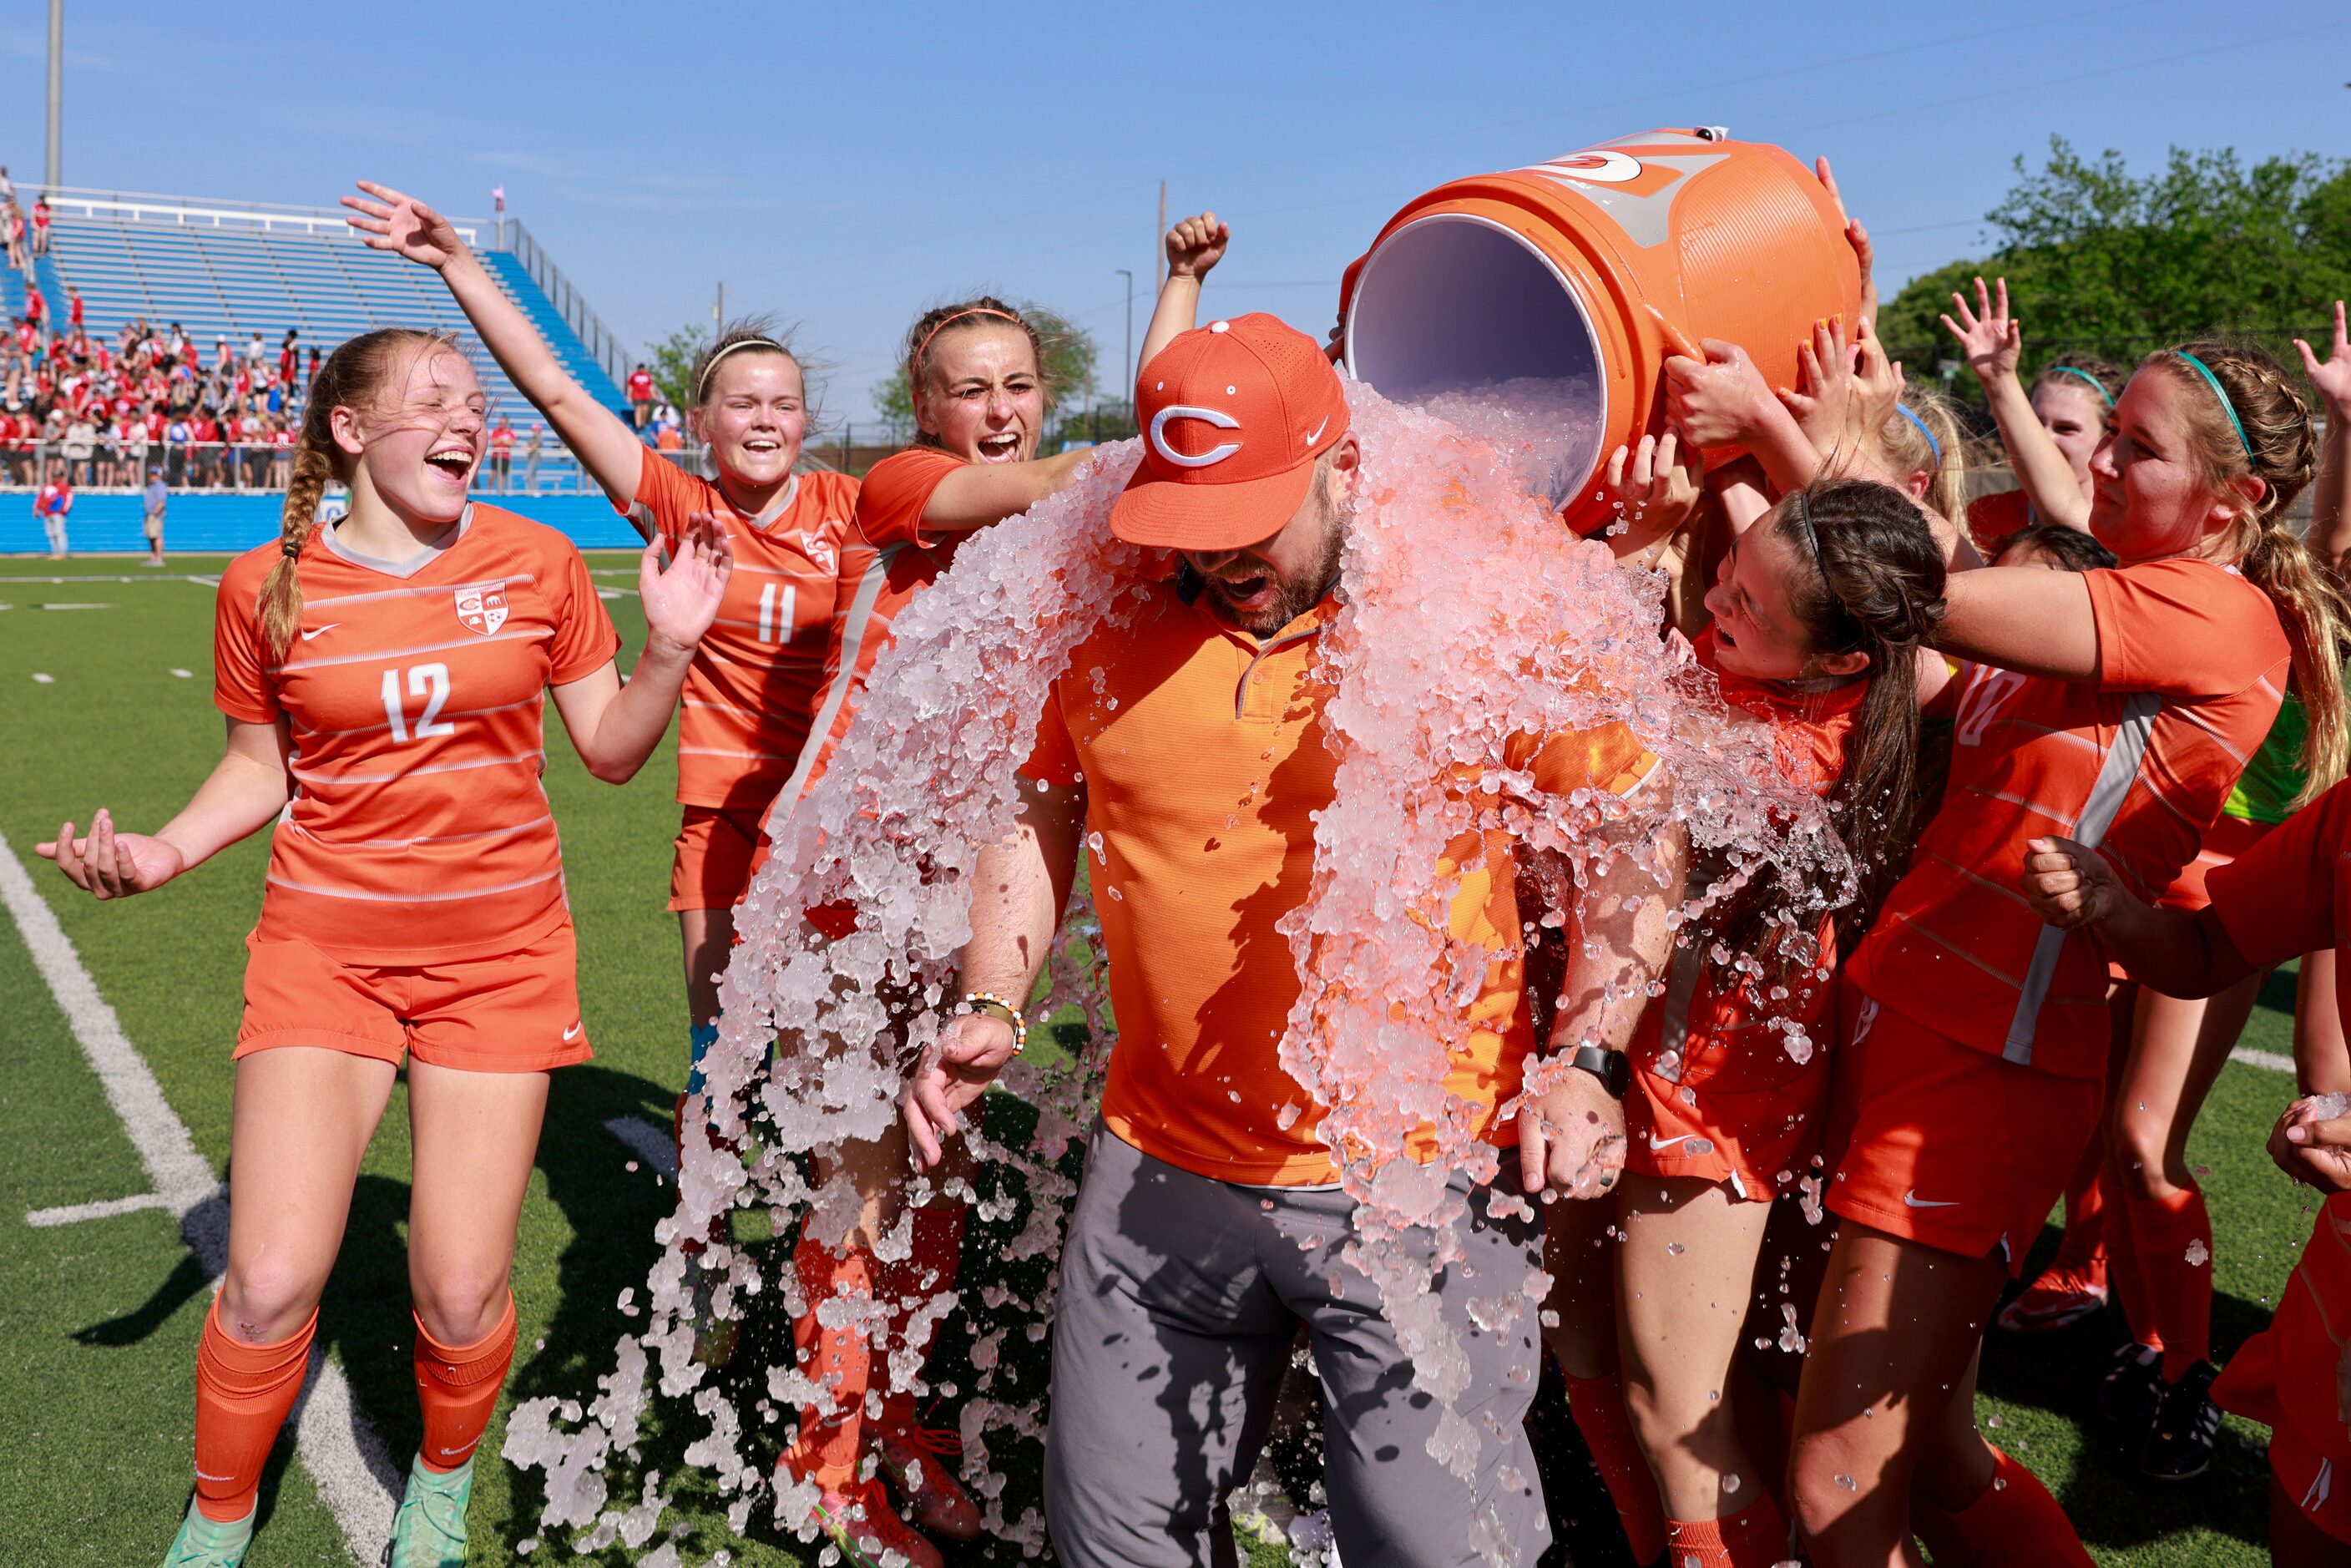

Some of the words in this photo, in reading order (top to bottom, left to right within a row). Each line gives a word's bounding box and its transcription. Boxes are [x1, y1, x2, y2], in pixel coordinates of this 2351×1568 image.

[1150, 404, 1243, 468] C
[758, 582, 796, 644] 11
[381, 662, 455, 744] 12
